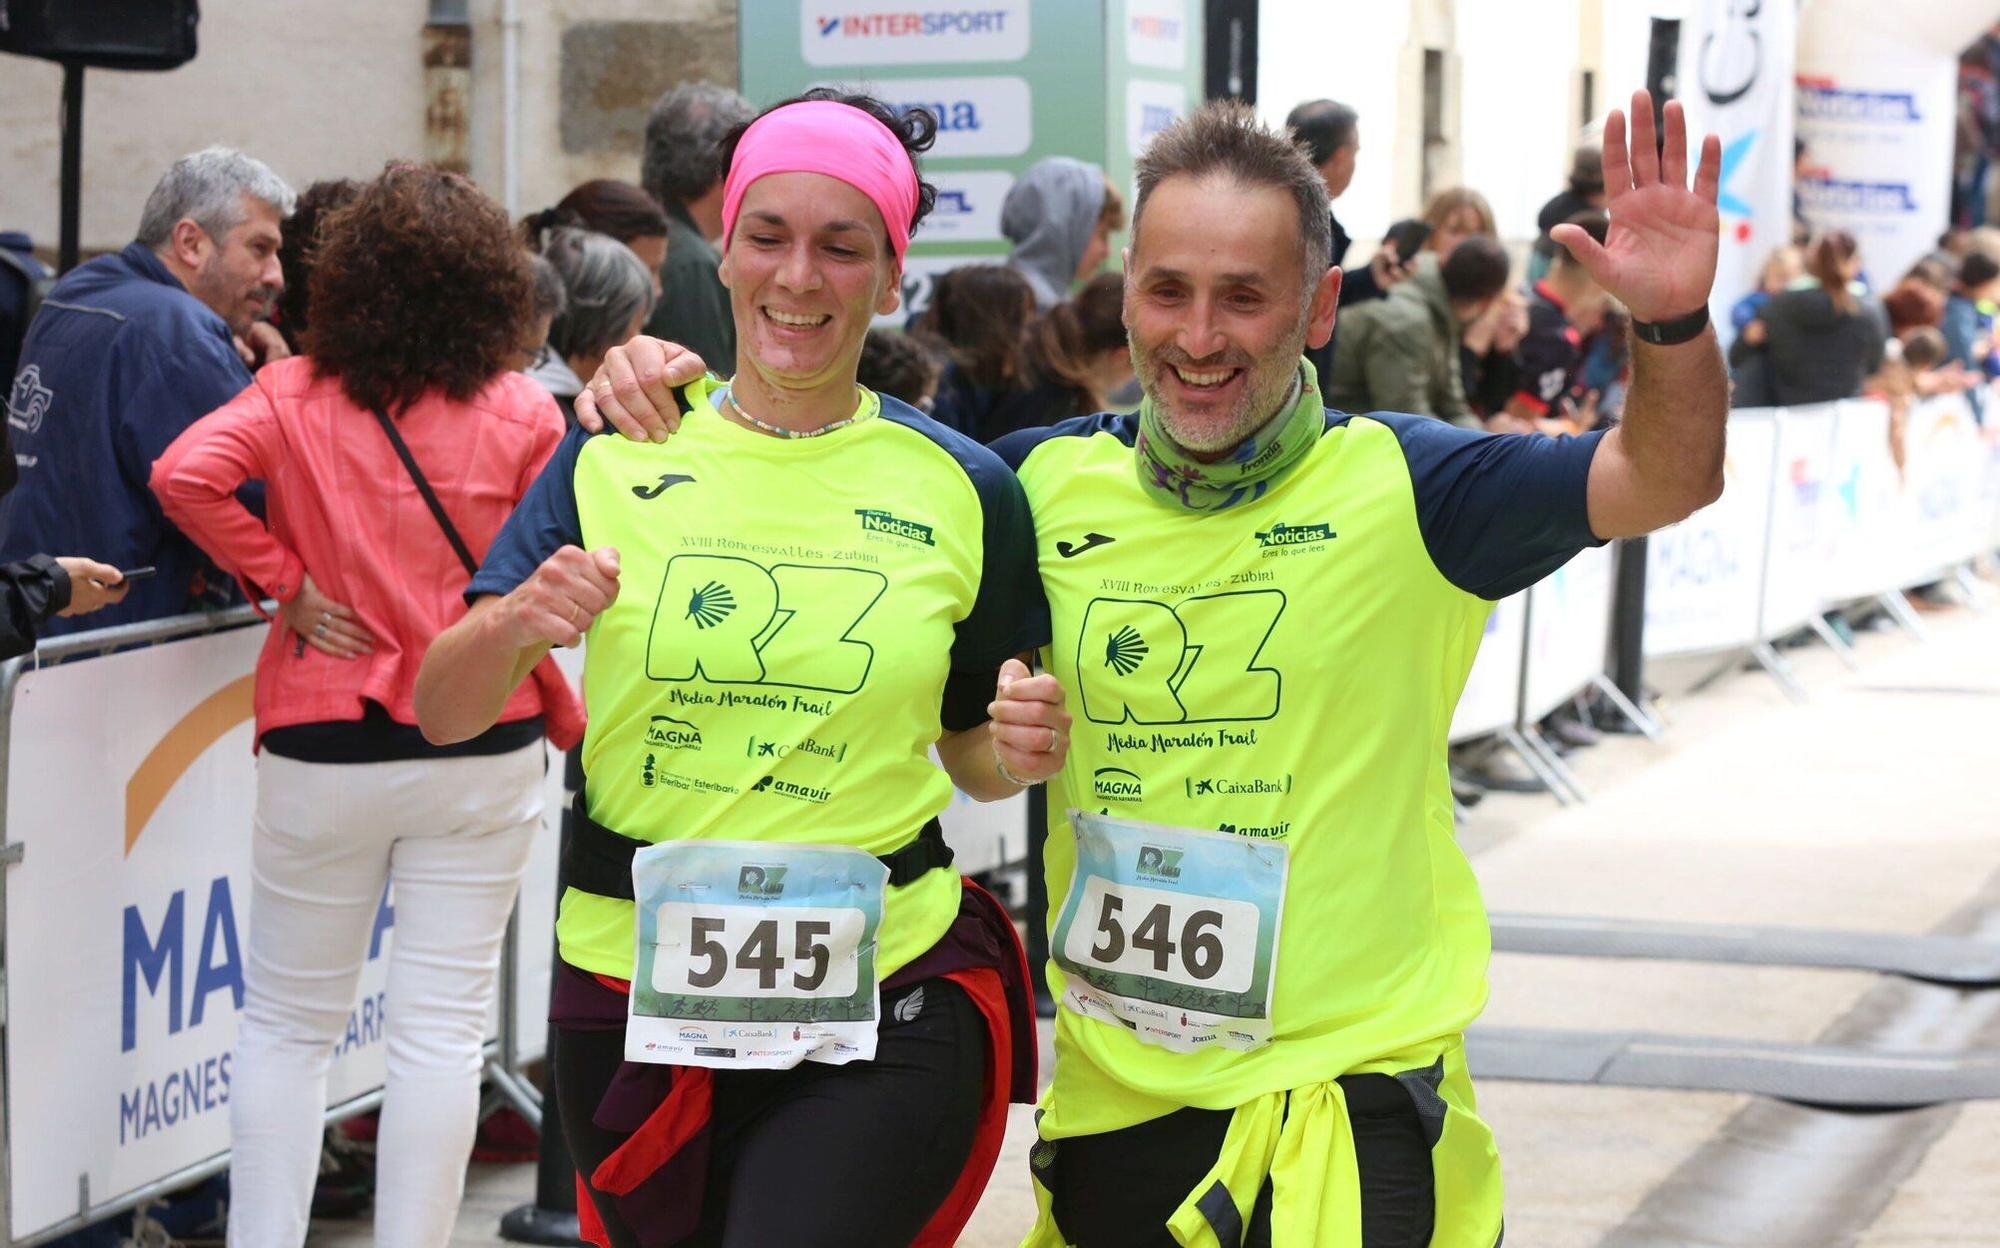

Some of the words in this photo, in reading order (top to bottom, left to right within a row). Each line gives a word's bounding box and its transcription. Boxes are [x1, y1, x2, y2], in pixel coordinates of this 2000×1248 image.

[842, 11, 1008, 37] INTERSPORT
[865, 515, 928, 541] Noticias
[680, 535, 713, 547] XVIII
[1100, 578, 1130, 592] XVIII
[669, 689, 714, 704] Media
[717, 692, 787, 711] Maratón
[792, 695, 833, 716] Trail
[647, 725, 702, 744] MAGNA
[1107, 732, 1148, 752] Media
[1150, 731, 1213, 753] Maratón
[1219, 728, 1257, 746] Trail
[775, 781, 831, 800] amavir
[1095, 781, 1141, 795] MAGNA
[1216, 778, 1283, 795] CaixaBank
[1239, 821, 1290, 837] amavir
[1091, 893, 1224, 980] 546
[687, 917, 831, 991] 545
[680, 1032, 708, 1040] MAGNA
[738, 1029, 773, 1038] CaixaBank
